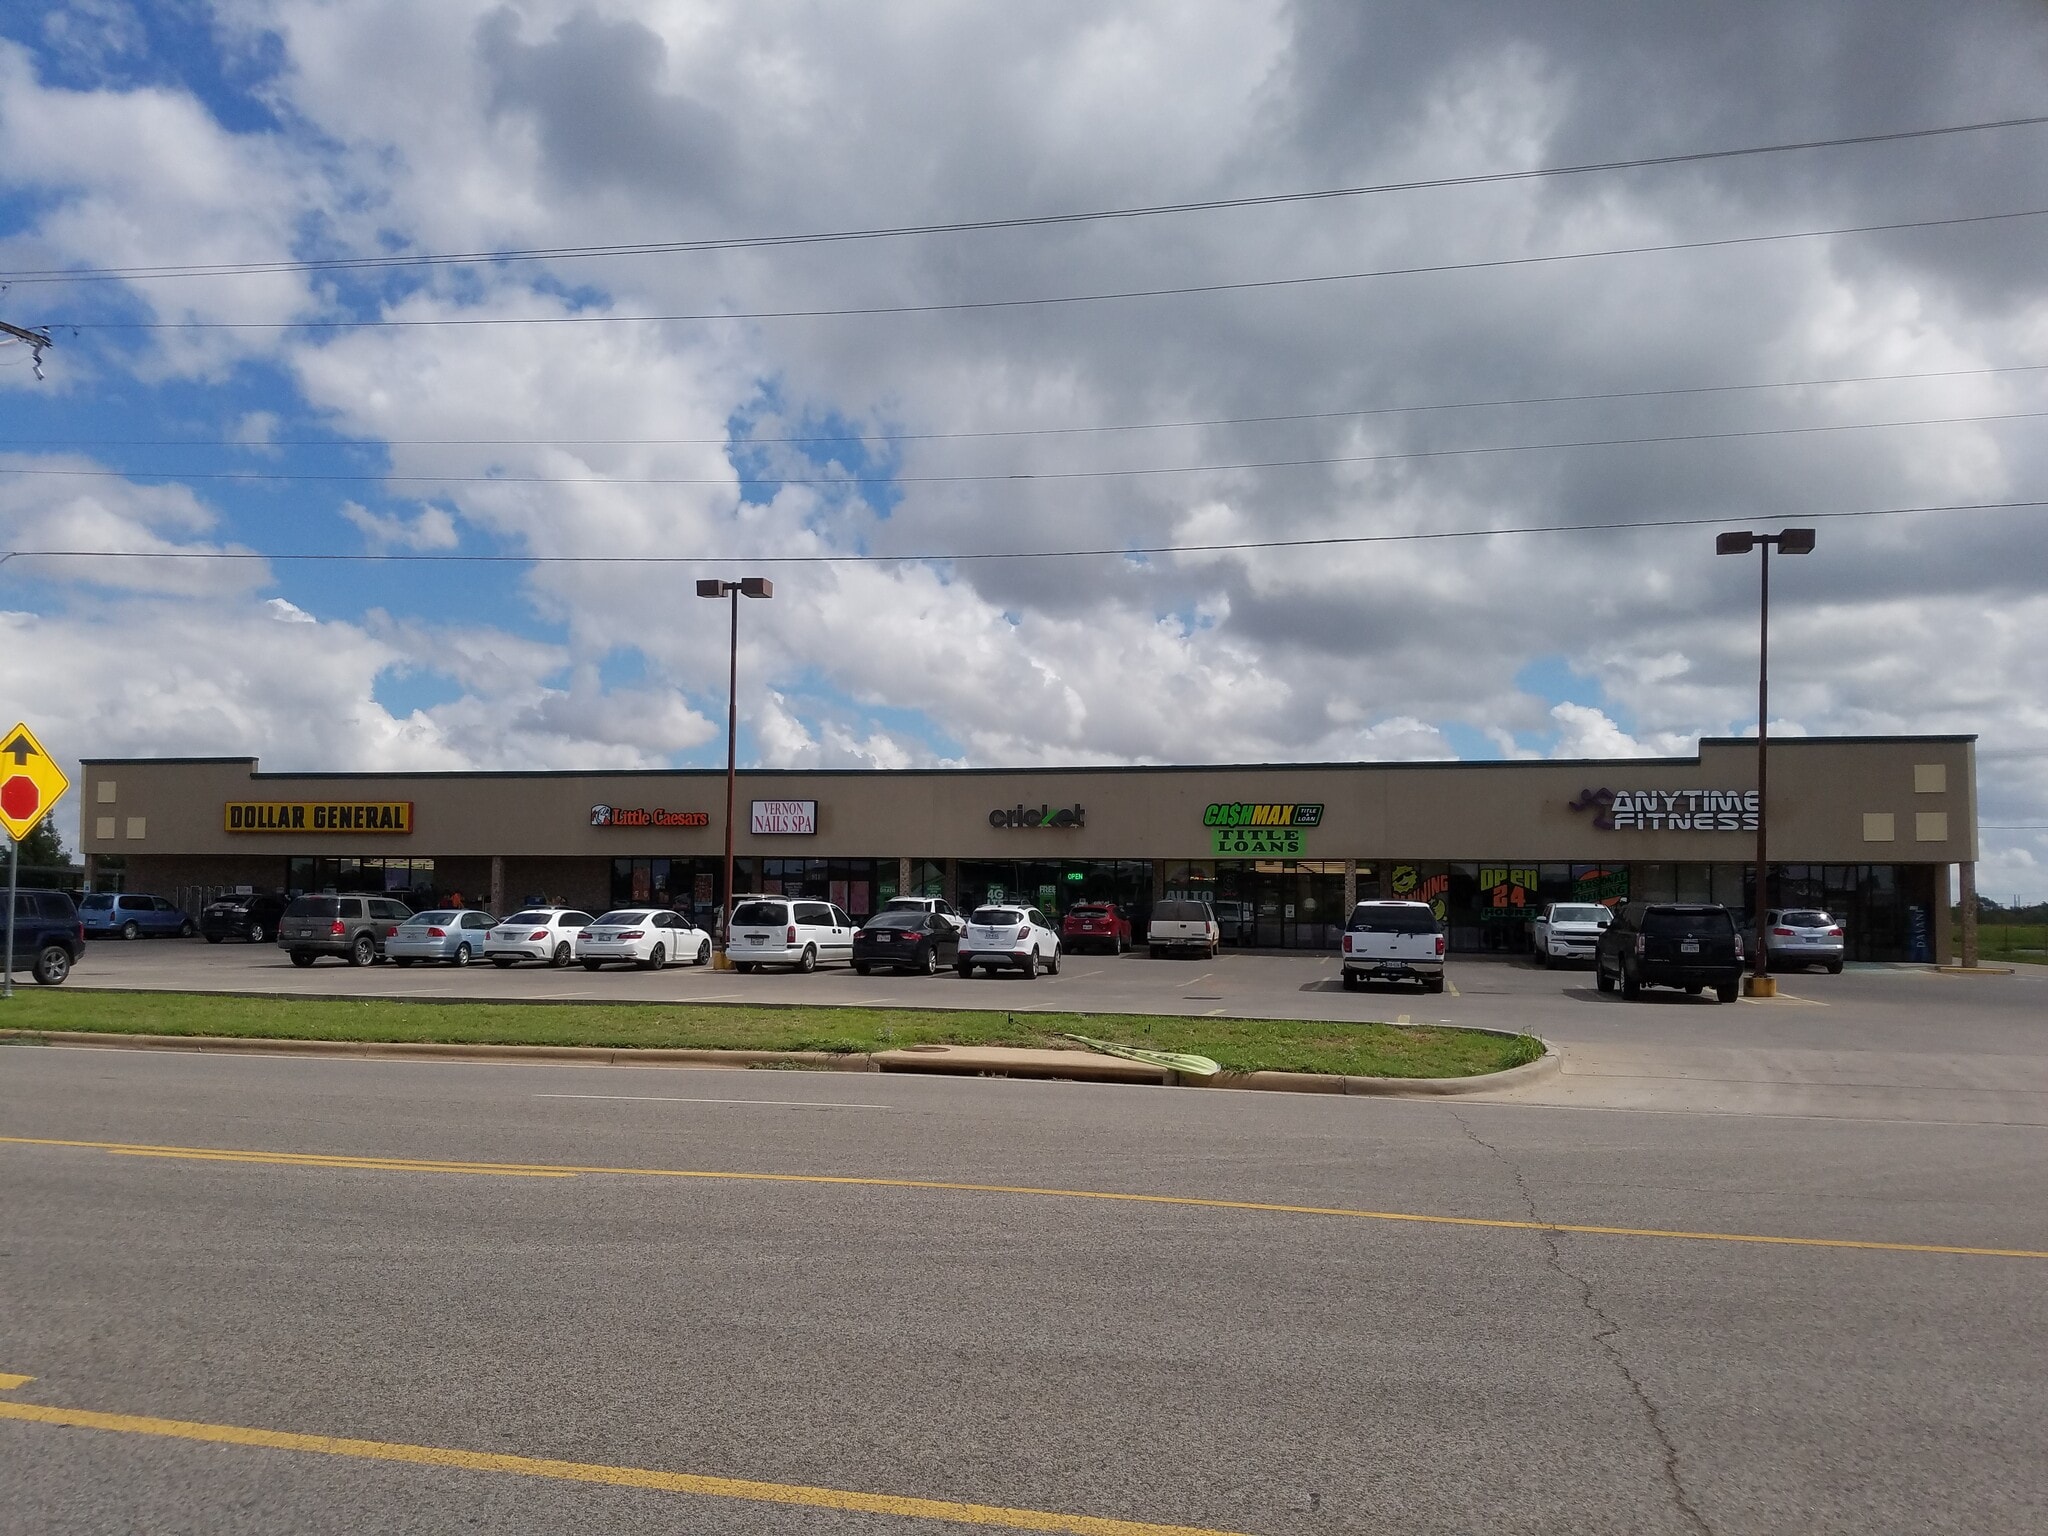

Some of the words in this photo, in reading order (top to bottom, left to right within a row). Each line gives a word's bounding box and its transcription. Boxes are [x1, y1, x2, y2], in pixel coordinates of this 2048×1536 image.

[1611, 790, 1759, 811] ANYTIME
[764, 802, 804, 815] VERNON
[989, 803, 1085, 828] cricket
[230, 806, 305, 828] DOLLAR
[313, 806, 404, 828] GENERAL
[612, 808, 651, 826] Little
[653, 808, 709, 826] Caesars
[755, 815, 789, 832] NAILS
[791, 815, 812, 832] SPA
[1614, 812, 1759, 831] FITNESS
[1218, 829, 1299, 841] TITLE
[1218, 841, 1299, 852] LOANS
[987, 889, 1004, 899] 4G
[1039, 885, 1057, 893] FREE
[1166, 890, 1215, 902] AUTO
[1493, 884, 1527, 908] 24
[1483, 908, 1535, 918] HOURS
